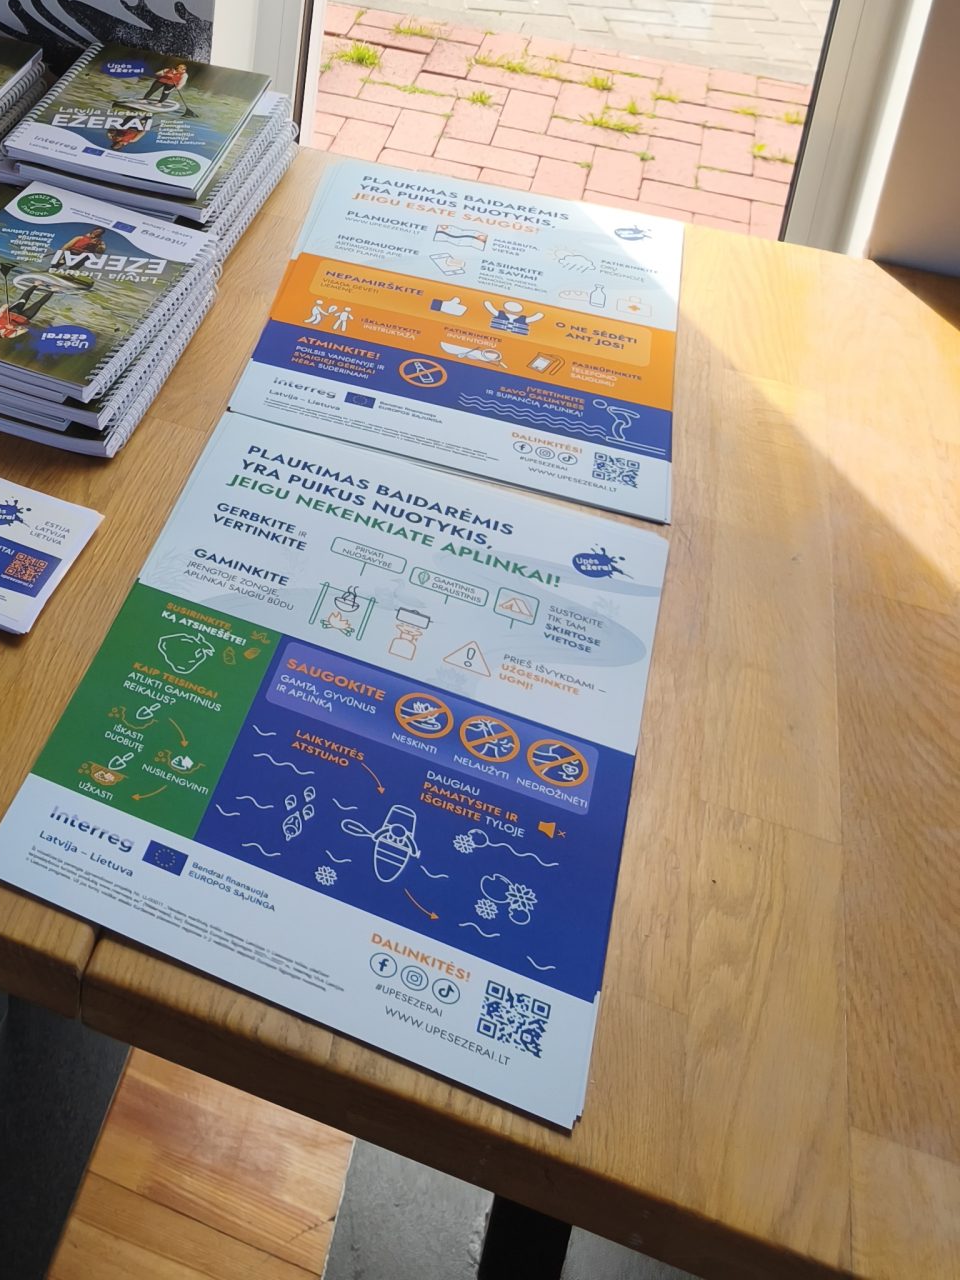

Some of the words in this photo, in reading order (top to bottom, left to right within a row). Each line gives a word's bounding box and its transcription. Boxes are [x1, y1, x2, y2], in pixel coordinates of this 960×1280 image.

[52, 113, 152, 130] EŽERAI
[60, 106, 101, 114] Latvija
[359, 184, 391, 194] YRA
[397, 191, 457, 207] PUIKUS
[362, 176, 458, 198] PLAUKIMAS
[464, 195, 569, 219] BAIDARĖMIS
[346, 210, 428, 231] PLANUOKITE
[351, 192, 400, 206] JEIGU
[406, 202, 455, 217] ESATE
[463, 213, 539, 233] SAUGŪS!
[337, 234, 419, 255] INFORMUOKITE
[50, 267, 103, 278] Lietuva
[52, 249, 168, 274] EŽERAI
[481, 259, 543, 275] PASIIMKITE
[109, 272, 157, 284] Latvija
[325, 270, 424, 296] NEPAMIRŠKITE
[497, 268, 537, 281] SAVIMI
[44, 332, 87, 341] ežerai
[565, 332, 591, 342] ANT
[594, 338, 624, 349] JOS!
[569, 324, 586, 333] NE
[59, 339, 88, 349] Upės
[295, 345, 325, 355] POILSIS
[327, 353, 374, 367] VANDENYJE
[297, 335, 380, 359] ATMINKITE!
[268, 389, 298, 400] Latvija
[307, 399, 340, 410] Lietuva
[273, 377, 336, 398] Interreg
[247, 445, 370, 490] PLAUKIMAS
[375, 484, 514, 535] BAIDARĖMIS
[238, 459, 283, 480] YRA
[287, 474, 366, 506] PUIKUS
[372, 500, 492, 548] NUOTYKIS,
[43, 521, 71, 533] ESTIJA
[215, 501, 296, 534] GERBKITE
[28, 530, 62, 545] LIETUVA
[34, 525, 66, 539] LATVIJA
[210, 513, 307, 551] VERTINKITE
[225, 474, 290, 500] JEIGU
[295, 494, 434, 546] NEKENKIATE
[440, 540, 560, 587] APLINKAI!
[341, 548, 392, 568] NUOSAVYBĖ
[355, 545, 385, 559] PRIVATI
[186, 560, 238, 582] ĮRENGTOJE
[238, 578, 281, 597] ZONOJE,
[192, 547, 289, 586] GAMINKITE
[183, 568, 226, 587] APLINKAI
[228, 584, 265, 601] SAUGIU
[267, 597, 294, 610] BŪDU
[431, 582, 481, 602] DRAUSTINIS
[433, 576, 475, 594] GAMTINIS
[161, 611, 178, 622] KĄ
[178, 617, 246, 645] ATSINEŠĖTE!
[546, 613, 563, 624] TIK
[565, 619, 586, 631] TAM
[549, 605, 603, 627] SUSTOKITE
[543, 632, 591, 652] VIETOSE
[545, 623, 601, 646] SKIRTOSE
[132, 662, 160, 677] KAIP
[161, 672, 218, 698] TEISINGAI
[285, 658, 385, 701] SAUGOKITE
[500, 664, 579, 695] UŽGESINKITE
[503, 655, 532, 668] PRIEŠ
[535, 666, 594, 689] IŠVYKDAMI
[122, 680, 177, 705] REIKALUS?
[127, 671, 162, 689] ATLIKTI
[163, 684, 222, 711] GAMTINIUS
[275, 683, 286, 692] IR
[287, 688, 333, 712] APLINKĄ
[280, 673, 321, 694] GAMTĄ,
[322, 689, 376, 714] GYVŪNUS
[104, 731, 144, 752] DUOBUTĘ
[112, 725, 143, 741] IŠKASTI
[295, 729, 365, 760] LAIKYKITĖS
[391, 733, 437, 754] NESKINTI
[290, 740, 349, 766] ATSTUMO
[141, 764, 209, 795] NUSILENGVINTI
[453, 755, 509, 780] NELAUŽYTI
[77, 781, 113, 800] UŽKASTI
[426, 770, 480, 796] DAUGIAU
[516, 777, 587, 807] NEDROŽINĖTI
[423, 781, 501, 816] PAMATYSITE
[505, 811, 518, 822] IR
[420, 792, 481, 821] IŠGIRSITE
[484, 816, 524, 837] TYLOJE
[49, 805, 136, 851] Interreg
[39, 830, 79, 853] Latvija
[89, 852, 134, 876] Lietuva
[188, 870, 231, 893] EUROPOS
[191, 861, 222, 879] Bendrai
[222, 874, 269, 899] finansuoja
[371, 933, 470, 982] DALINKITĖS!
[375, 982, 443, 1017] #UPESEZERAI
[384, 1005, 510, 1067] WWW.UPESEZERAI.LT
